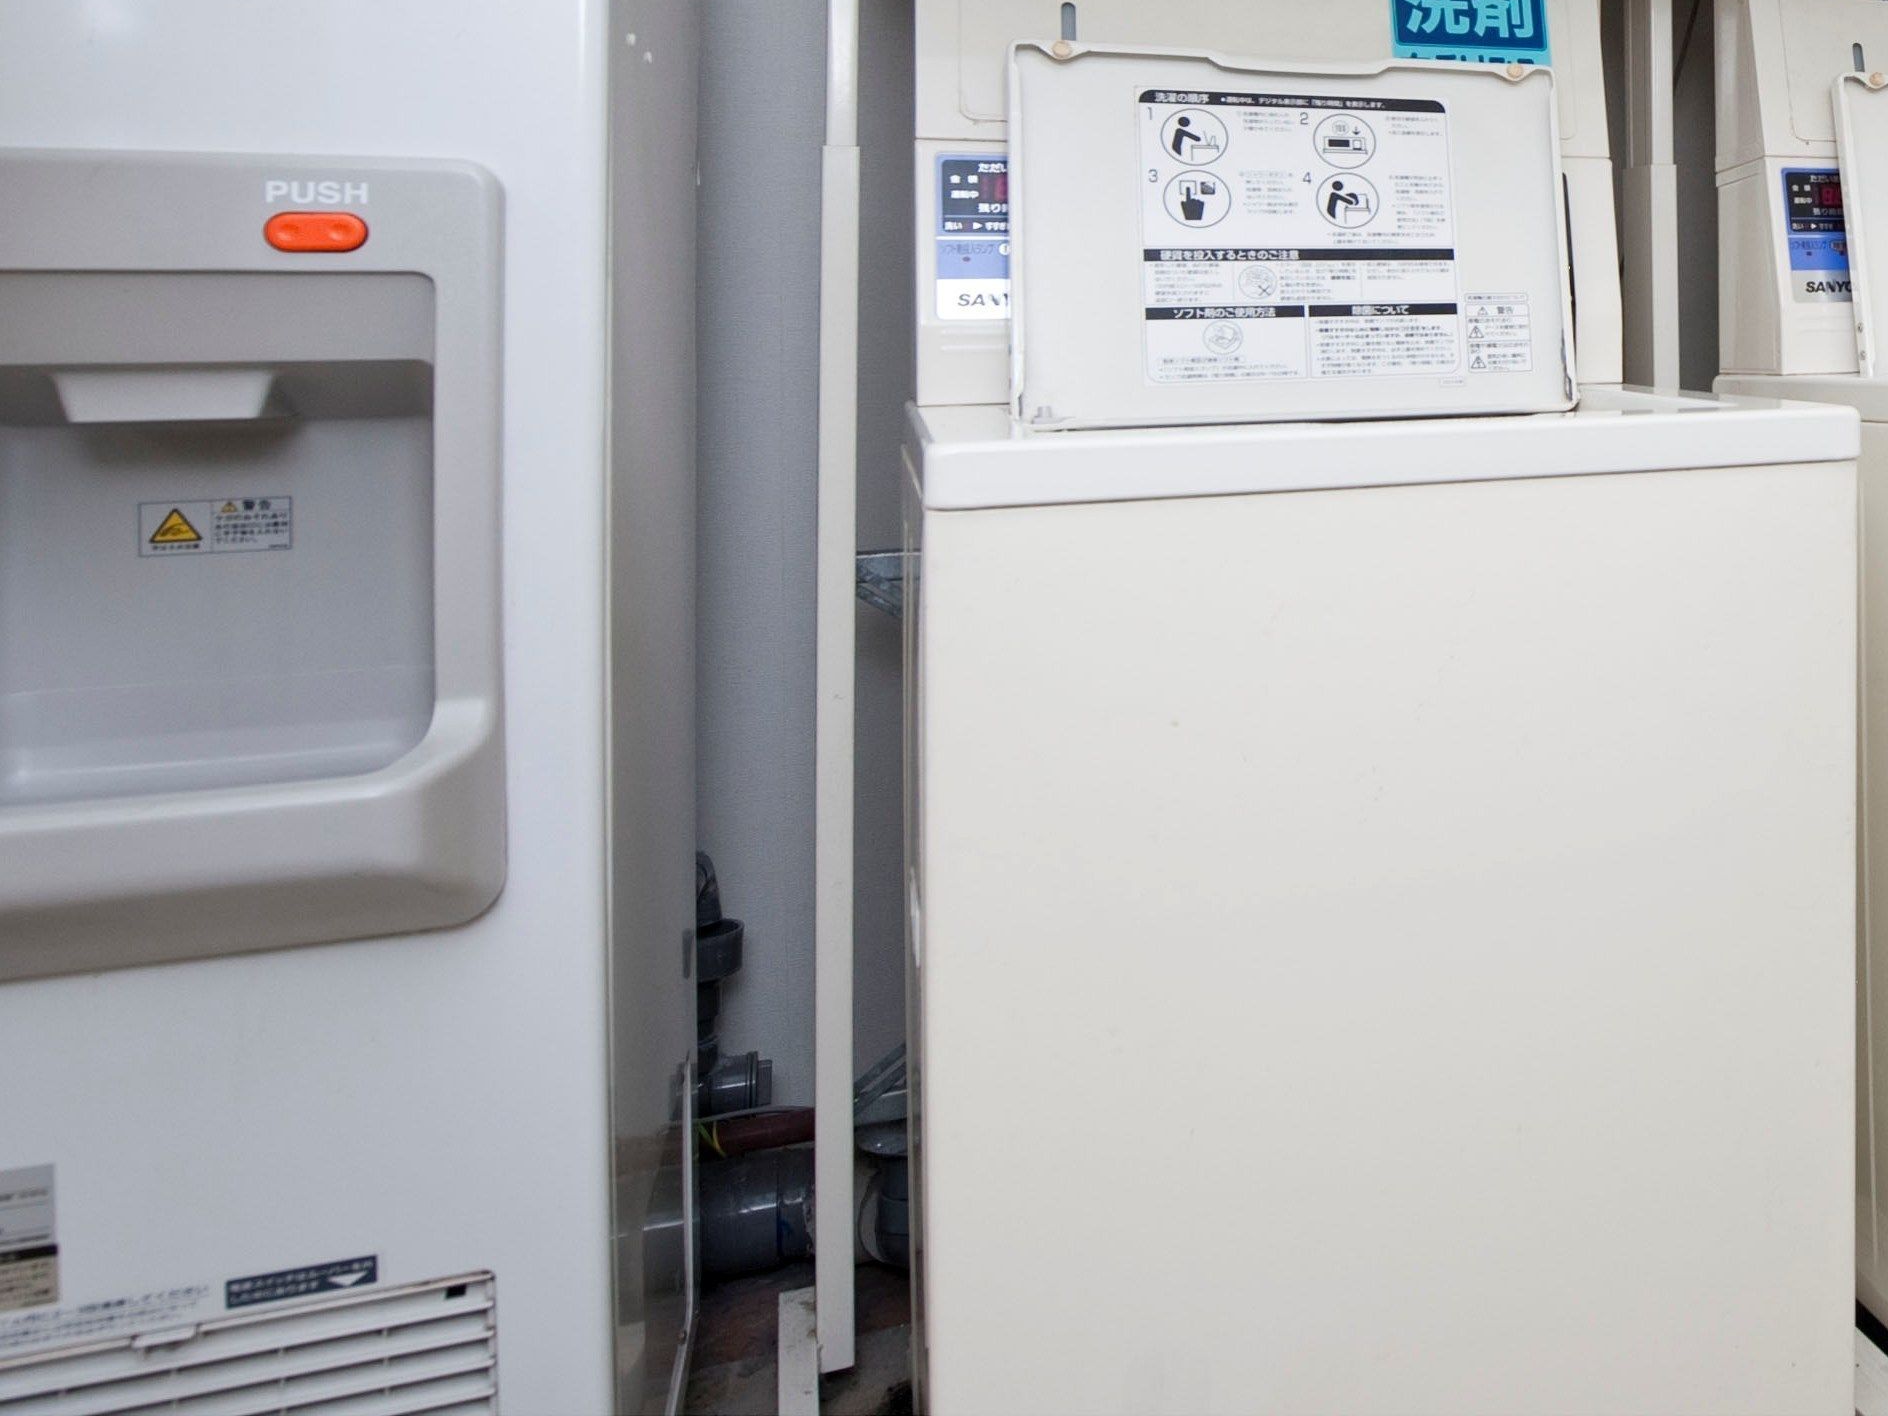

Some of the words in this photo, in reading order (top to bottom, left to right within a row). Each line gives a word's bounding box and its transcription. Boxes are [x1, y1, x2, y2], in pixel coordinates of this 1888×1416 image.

[1154, 93, 1210, 104] 洗濯の順序
[1299, 111, 1309, 126] 2
[1148, 169, 1158, 183] 3
[1302, 171, 1312, 184] 4
[264, 181, 369, 205] PUSH
[1160, 250, 1300, 261] 硬貨を投入するときのご注意
